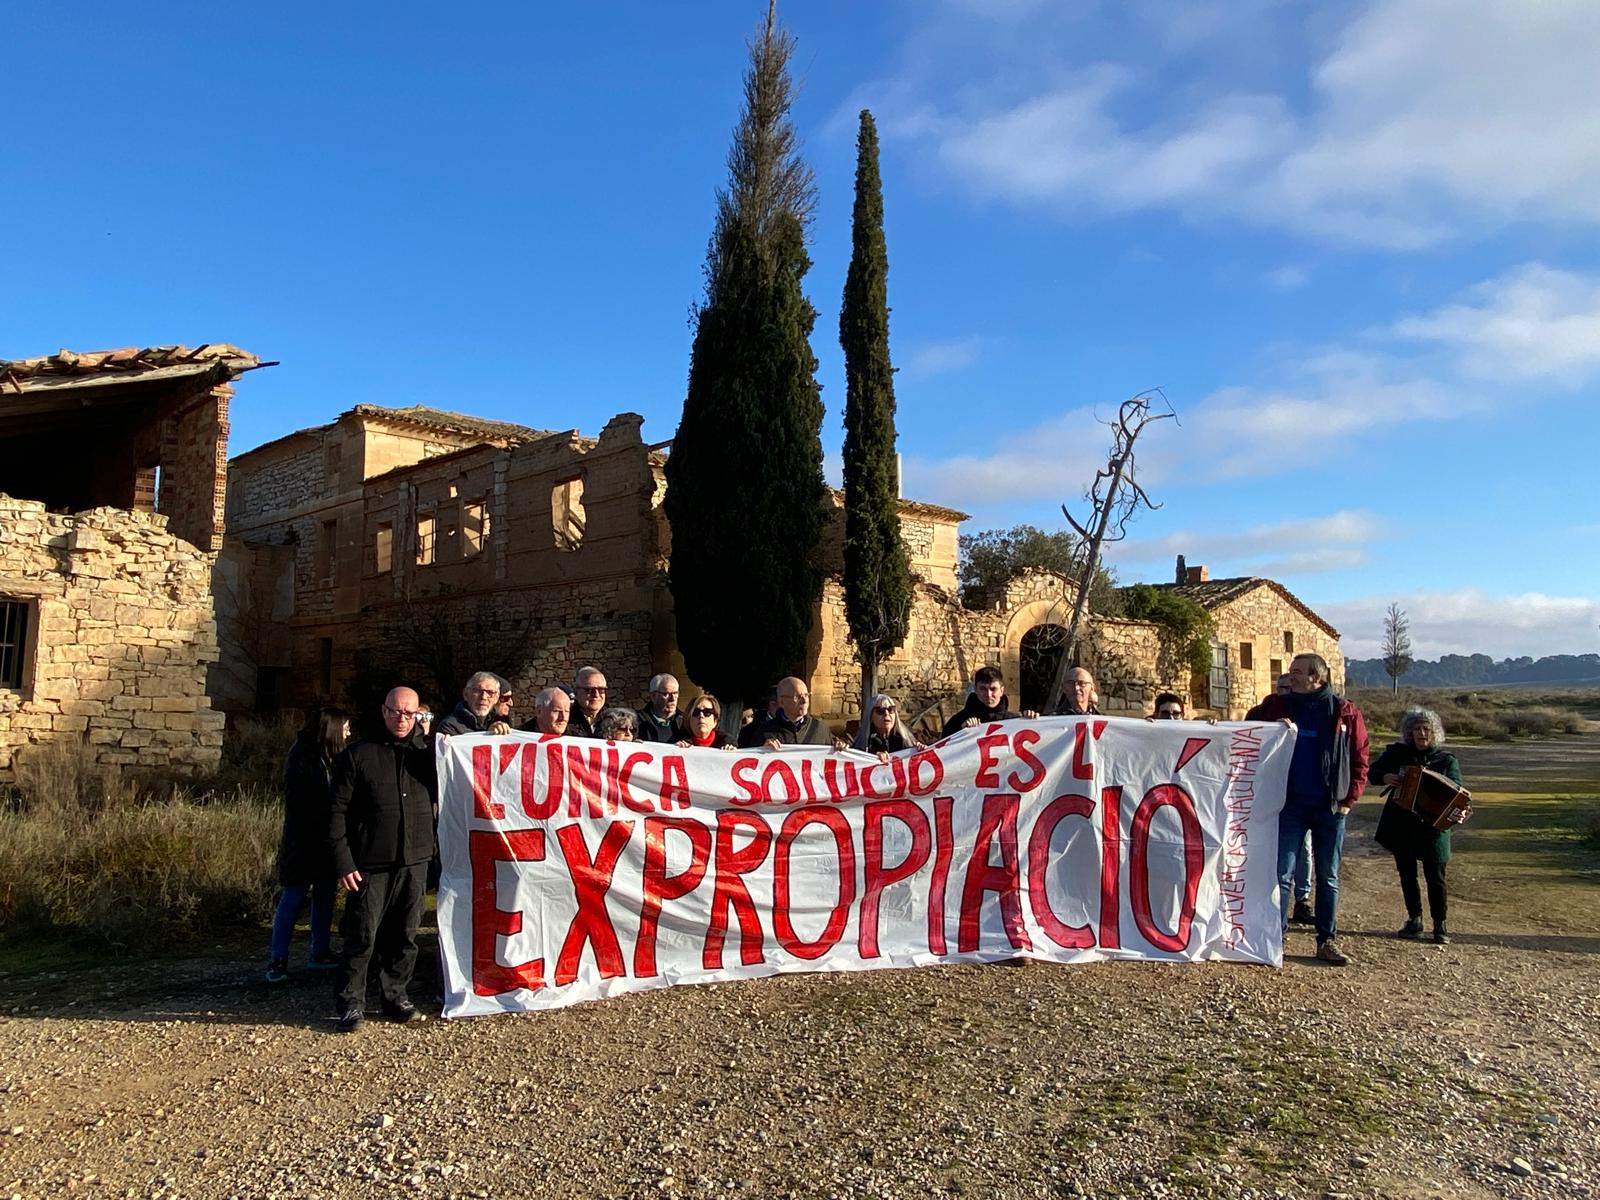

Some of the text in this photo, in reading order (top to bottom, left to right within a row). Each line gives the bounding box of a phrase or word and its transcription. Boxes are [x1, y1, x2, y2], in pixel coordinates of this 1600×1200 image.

[975, 724, 1047, 793] ÉS
[1072, 720, 1108, 780] L'
[469, 738, 1212, 997] EXPROPIACIÓ
